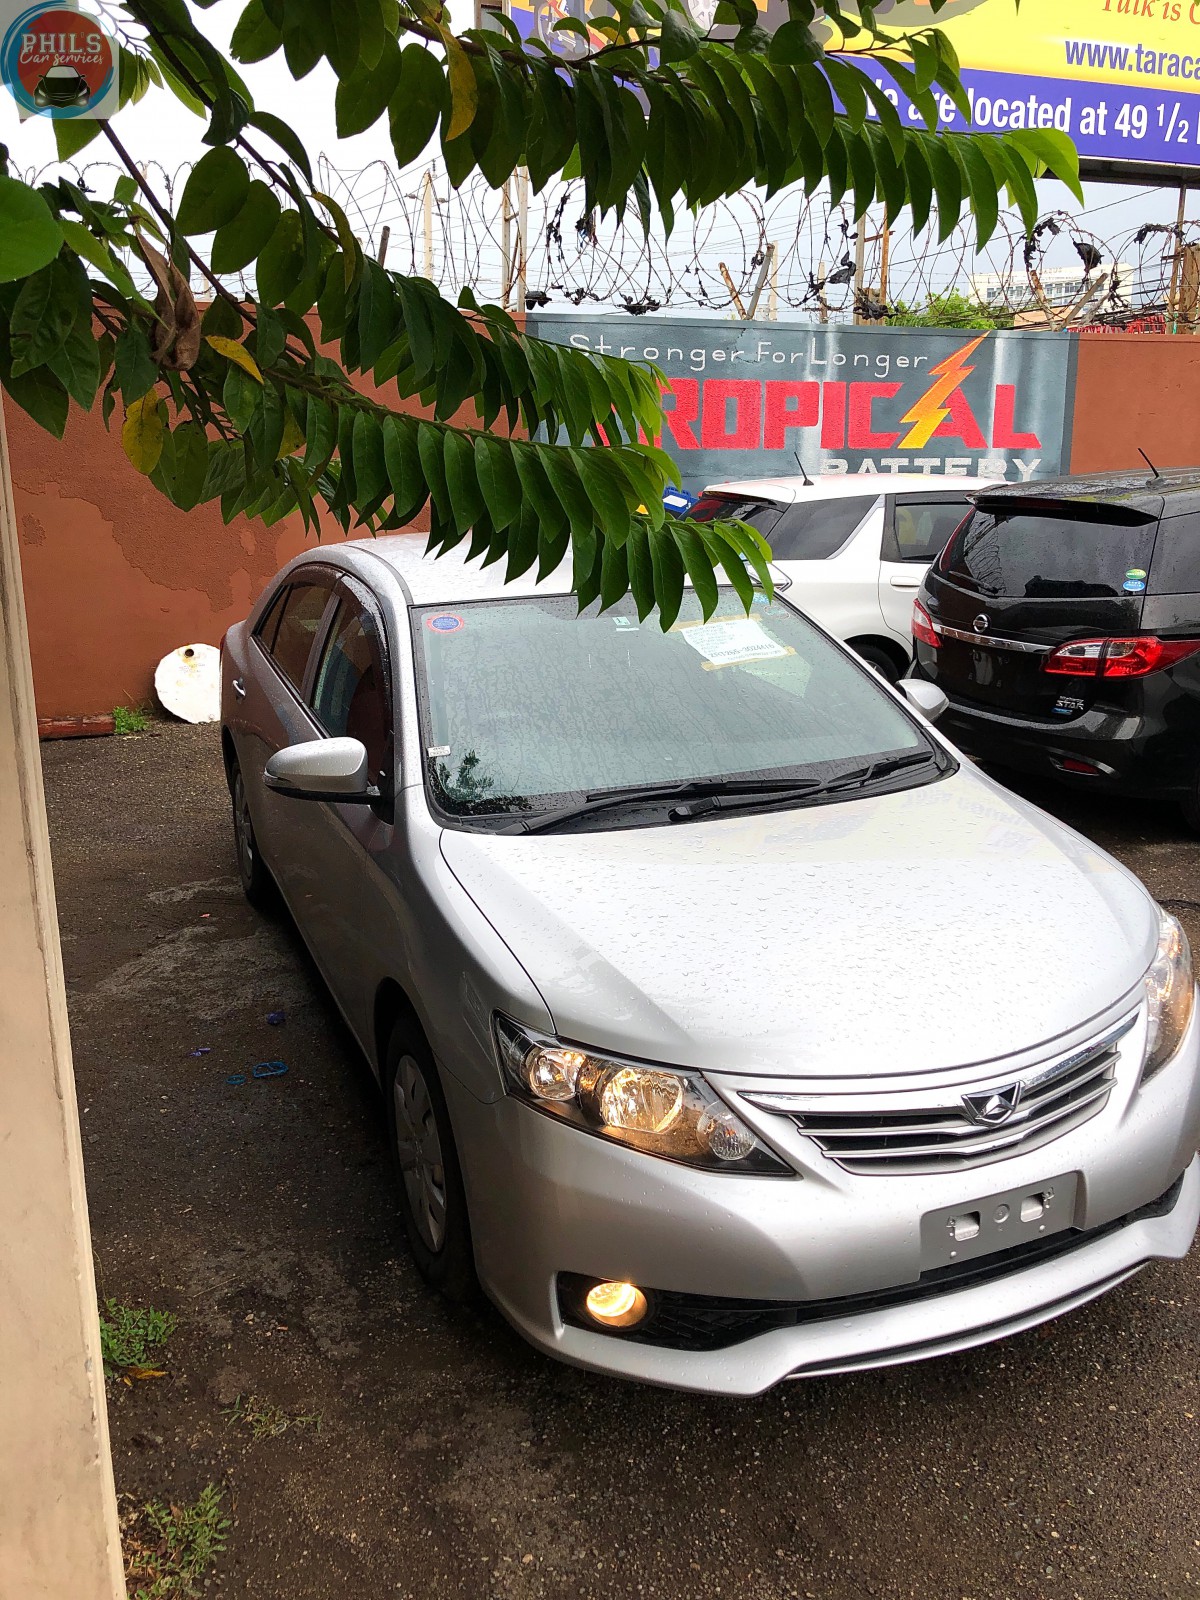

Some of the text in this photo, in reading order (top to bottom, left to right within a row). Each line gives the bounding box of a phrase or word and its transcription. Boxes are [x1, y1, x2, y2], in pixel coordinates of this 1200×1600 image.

[1162, 1, 1182, 21] is
[967, 88, 1072, 133] located
[1079, 101, 1108, 136] at
[1114, 103, 1148, 139] 49
[569, 334, 928, 378] Stronger For Longer
[592, 377, 1042, 450] ROPICAL
[820, 458, 1042, 482] BATTERY
